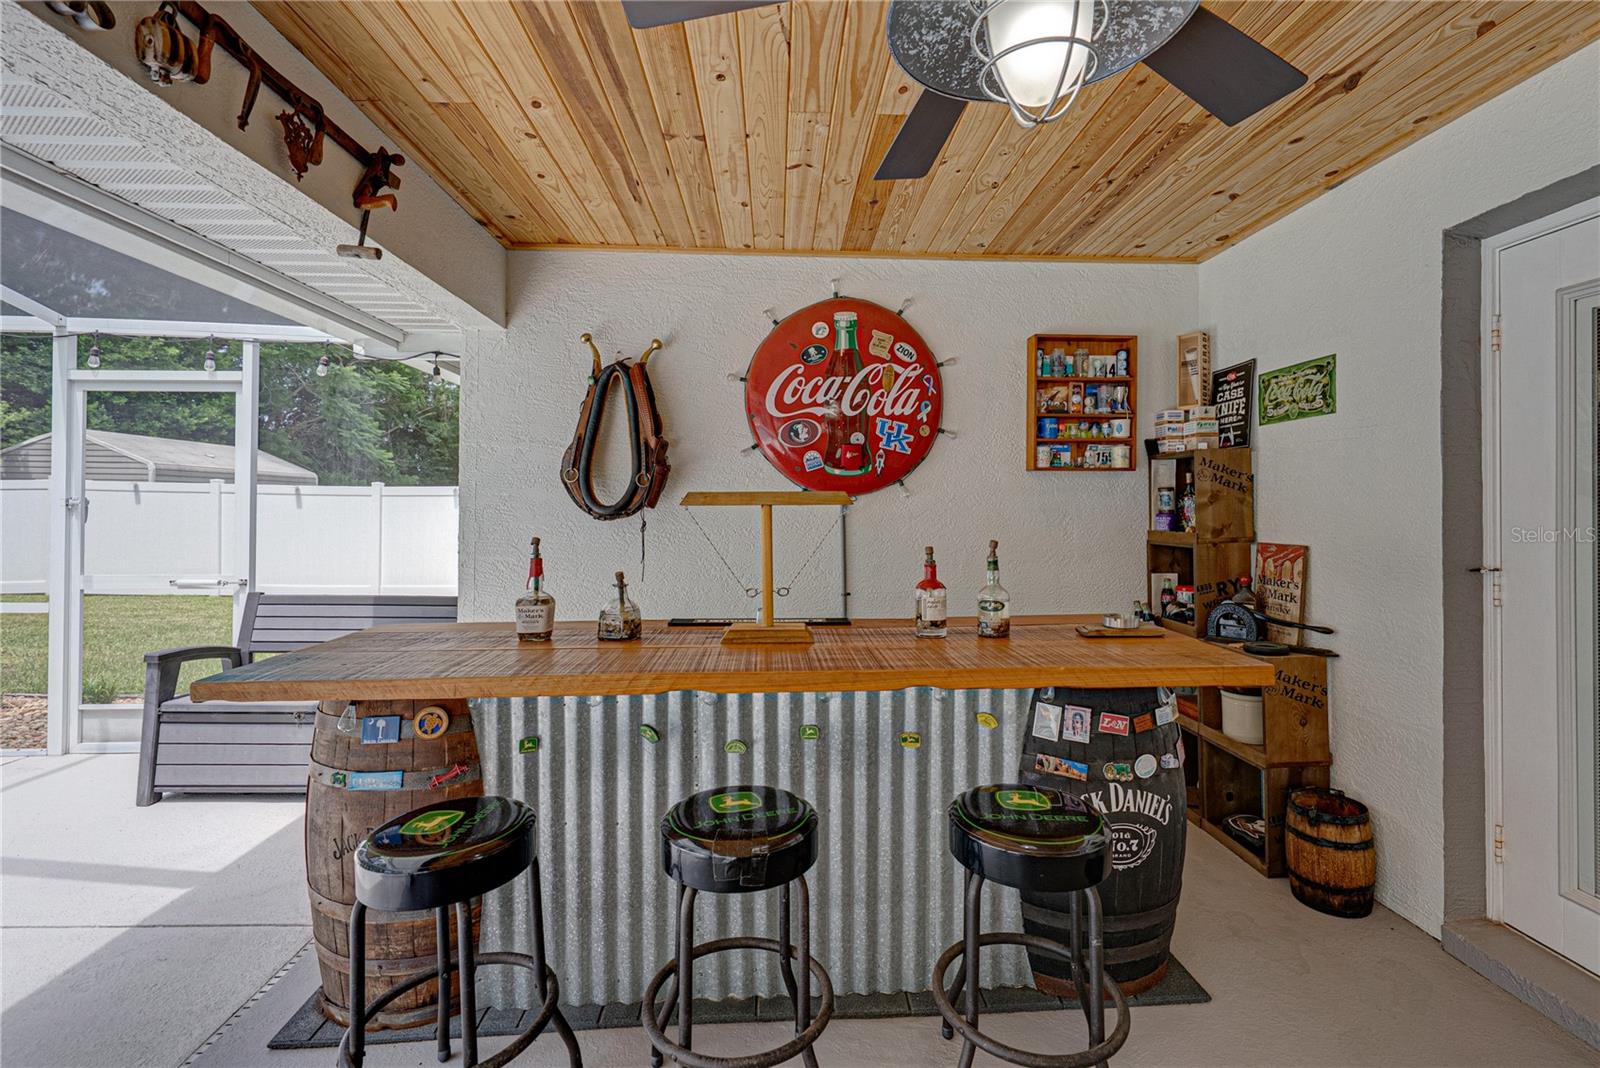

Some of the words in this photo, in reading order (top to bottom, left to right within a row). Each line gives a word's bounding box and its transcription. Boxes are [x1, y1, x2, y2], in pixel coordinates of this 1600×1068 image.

[896, 344, 915, 360] ZION
[766, 363, 923, 416] Coca-Cola
[1216, 387, 1245, 403] CASE
[876, 418, 914, 455] UK
[1200, 457, 1254, 482] Maker's
[1210, 473, 1250, 495] Mark
[1258, 575, 1300, 591] Maker's
[1267, 587, 1298, 603] Mark
[1280, 685, 1324, 709] Mark
